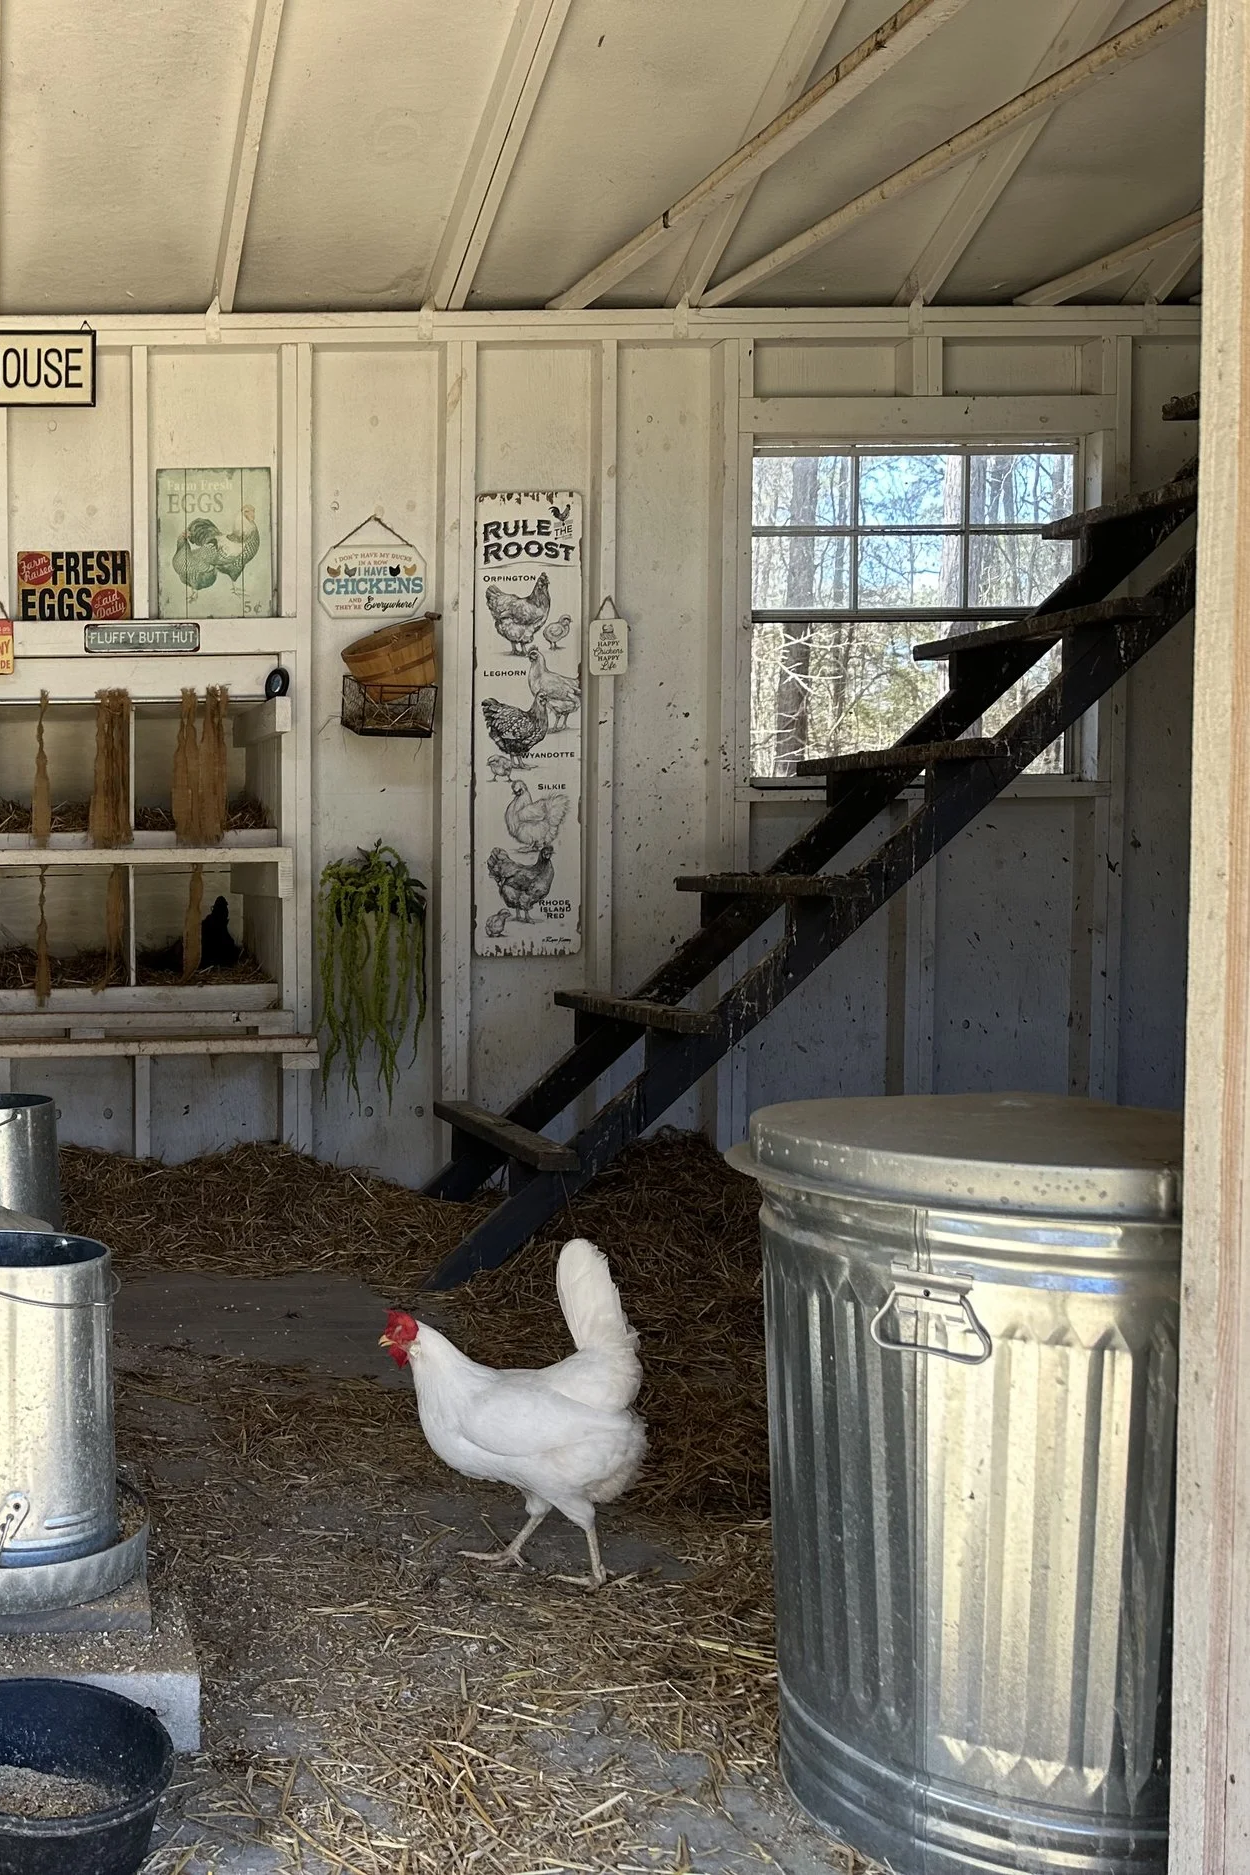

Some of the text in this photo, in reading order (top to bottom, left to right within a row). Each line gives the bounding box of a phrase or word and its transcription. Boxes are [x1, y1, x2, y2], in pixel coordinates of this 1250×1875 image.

[167, 479, 233, 491] Farm Fresh
[166, 493, 224, 514] EGGS
[483, 519, 573, 543] RULE THE
[339, 553, 359, 562] DON'T
[391, 553, 412, 562] DUCKS
[483, 540, 575, 565] ROOST
[19, 556, 55, 582] Farm Raised
[51, 551, 127, 585] FRESH
[363, 566, 388, 576] HAVE
[322, 577, 423, 595] CHICKENS
[22, 587, 92, 621] EGGS
[95, 590, 120, 609] Laid
[364, 595, 418, 612] Everywhere!
[96, 601, 126, 619] Daily
[90, 631, 194, 644] FLUFFY BUTT HUT
[593, 647, 624, 657] Chickens
[600, 660, 617, 671] Life
